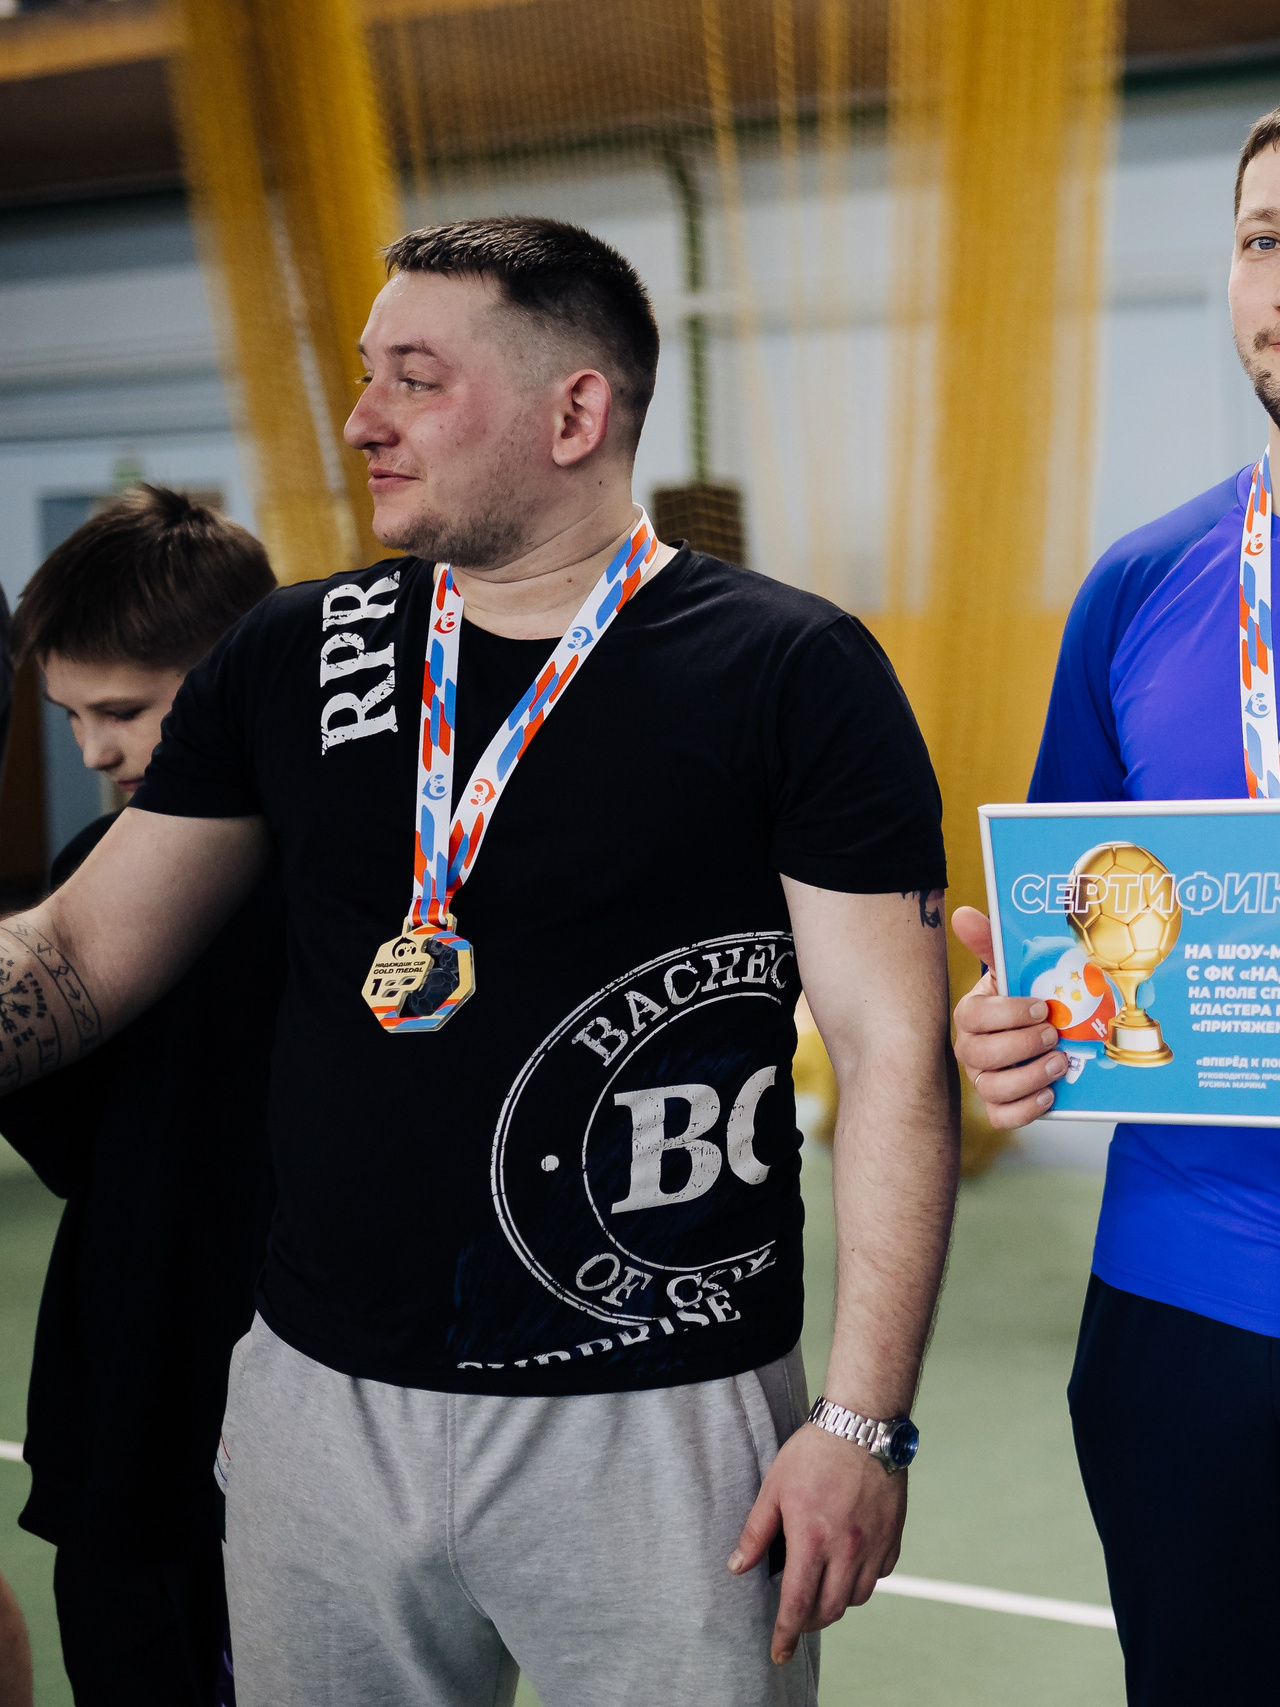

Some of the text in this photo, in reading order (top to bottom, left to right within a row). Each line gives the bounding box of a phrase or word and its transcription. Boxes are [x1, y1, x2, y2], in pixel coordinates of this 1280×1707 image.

[320, 571, 400, 755] RPR
[1184, 944, 1213, 960] НА
[1186, 966, 1200, 981] С
[1204, 965, 1235, 982] ФК
[1188, 986, 1210, 999] НА
[1214, 986, 1257, 1000] ПОЛЕ
[1189, 1003, 1272, 1017] КЛАСТЕРА
[1196, 1055, 1248, 1069] «ВПЕРЁД
[1250, 1057, 1259, 1067] К
[1198, 1072, 1260, 1080] РУКОВОДИТЕЛЬ
[575, 1252, 653, 1307] OF
